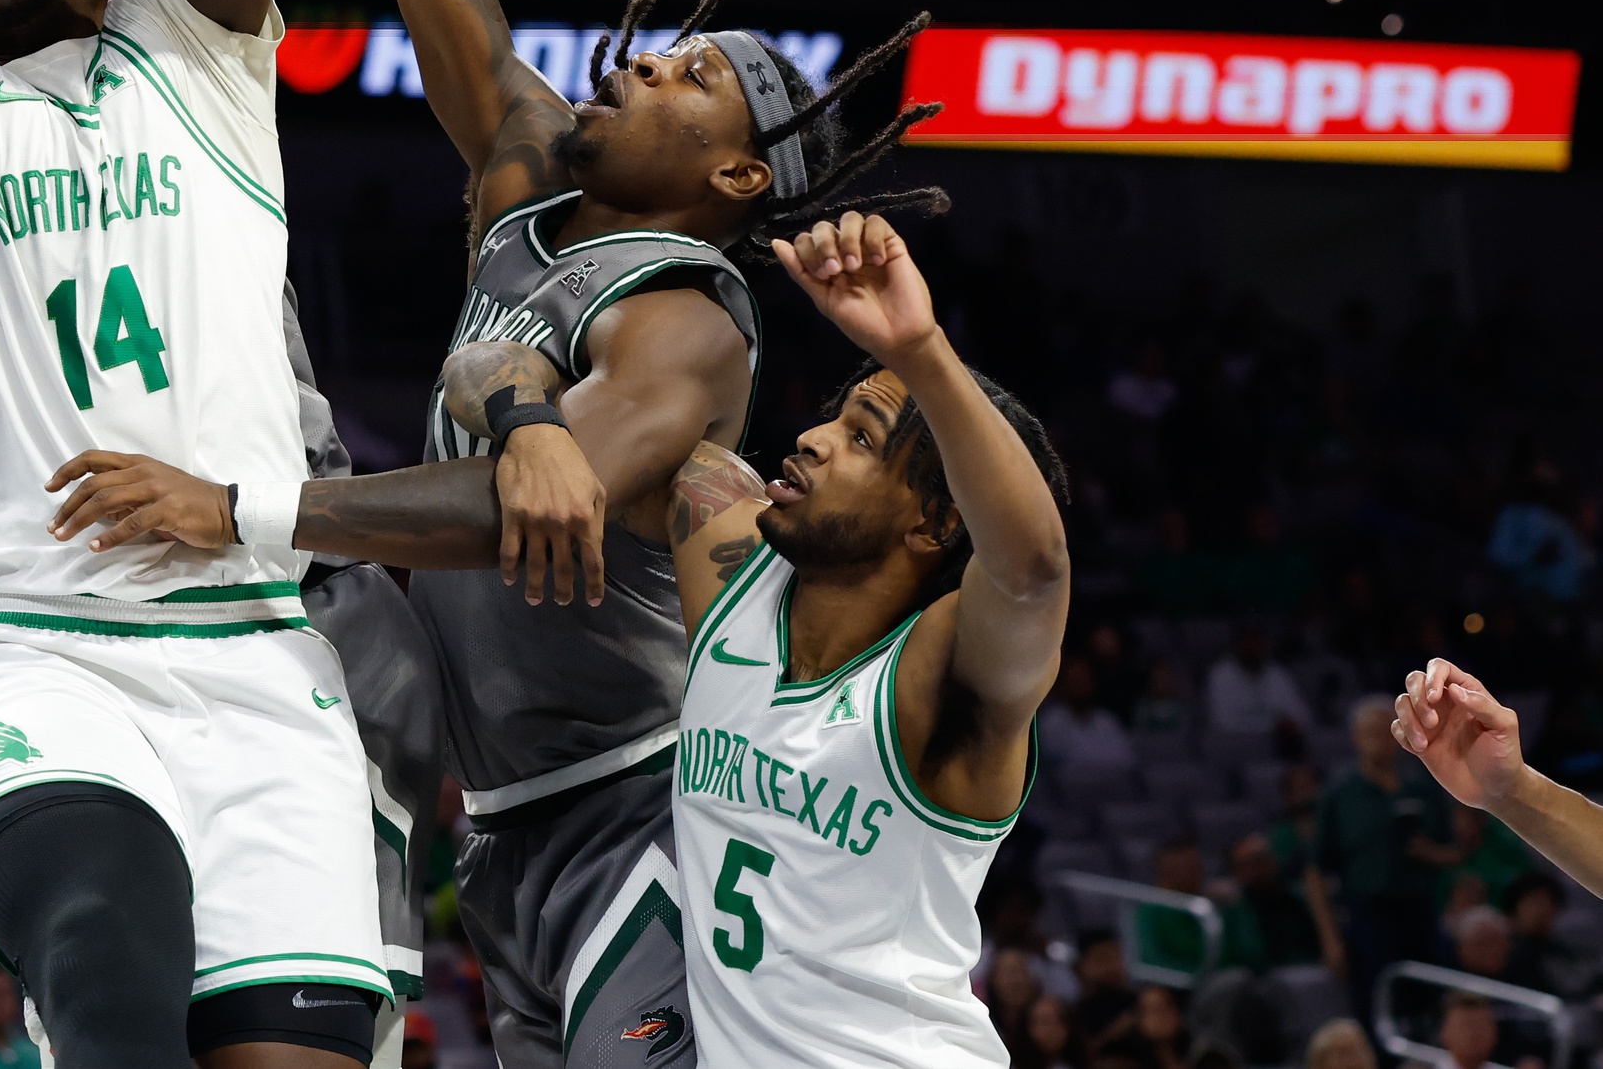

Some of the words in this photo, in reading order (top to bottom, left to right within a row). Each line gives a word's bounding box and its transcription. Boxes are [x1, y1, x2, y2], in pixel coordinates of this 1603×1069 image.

[99, 152, 181, 231] EXAS
[46, 265, 169, 410] 14
[679, 727, 749, 804] NORTH
[753, 747, 893, 856] TEXAS
[713, 838, 775, 973] 5
